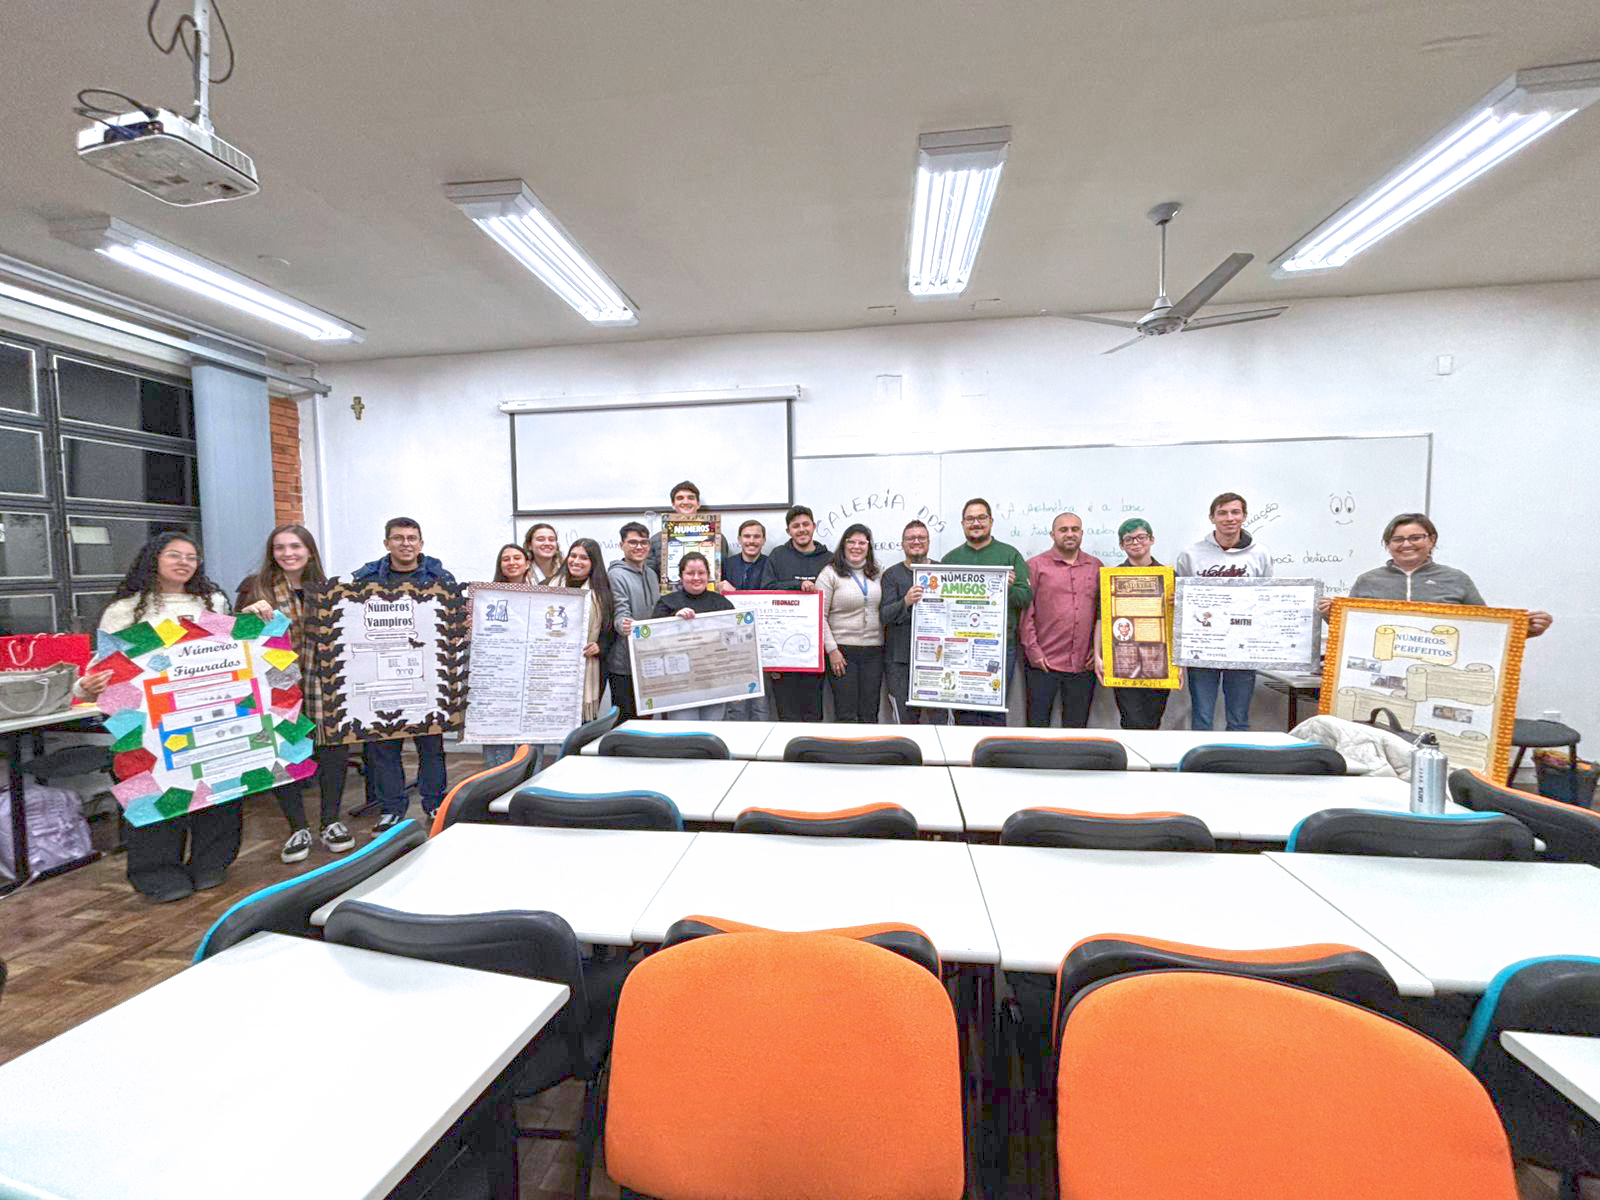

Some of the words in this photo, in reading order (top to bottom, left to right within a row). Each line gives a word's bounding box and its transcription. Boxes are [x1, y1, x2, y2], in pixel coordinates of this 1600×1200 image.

[918, 506, 947, 534] DOS
[940, 572, 985, 582] NÚMEROS
[941, 583, 987, 595] AMIGOS
[368, 602, 410, 612] Números
[367, 617, 412, 628] Vampiros
[1230, 618, 1252, 626] SMITH
[1396, 632, 1446, 646] NÚMEROS
[178, 642, 239, 658] Números
[1393, 644, 1452, 658] PERFEITOS
[173, 658, 241, 676] Figurados
